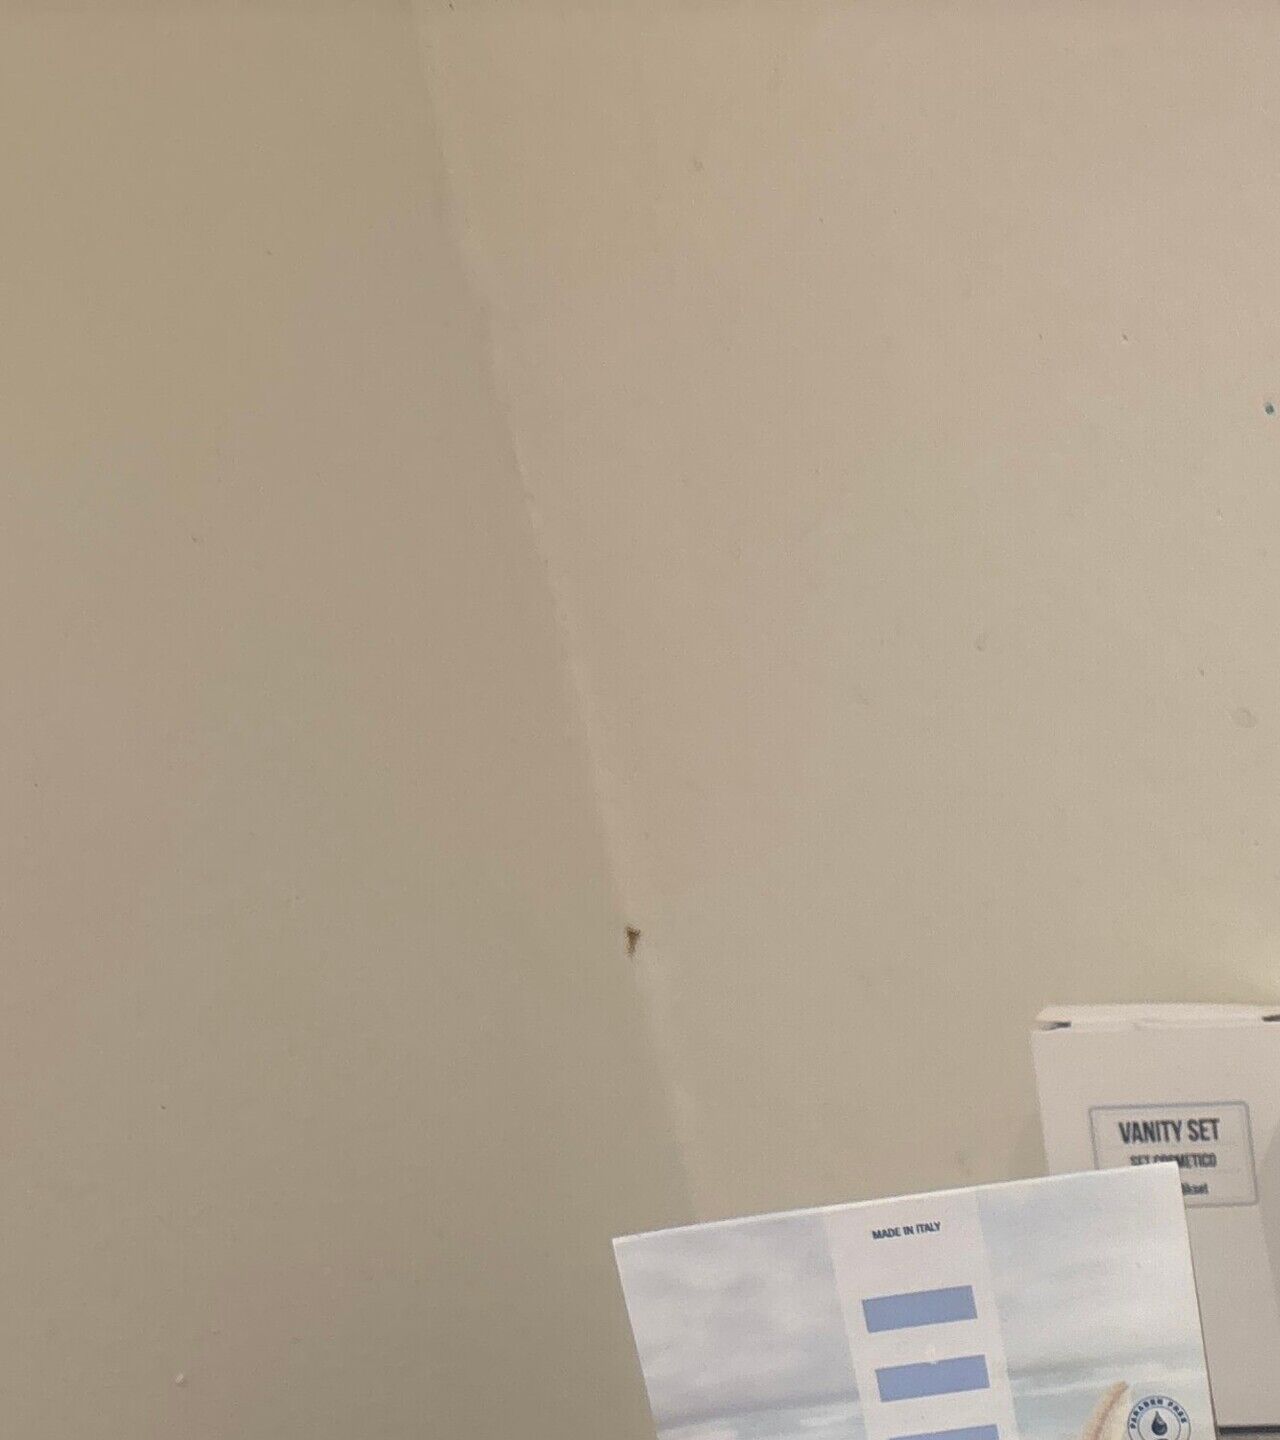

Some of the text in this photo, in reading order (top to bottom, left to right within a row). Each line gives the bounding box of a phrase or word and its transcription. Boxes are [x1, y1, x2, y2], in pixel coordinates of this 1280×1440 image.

[1118, 1117, 1220, 1144] VANITY SET
[871, 1220, 941, 1240] MADE IN ITALY
